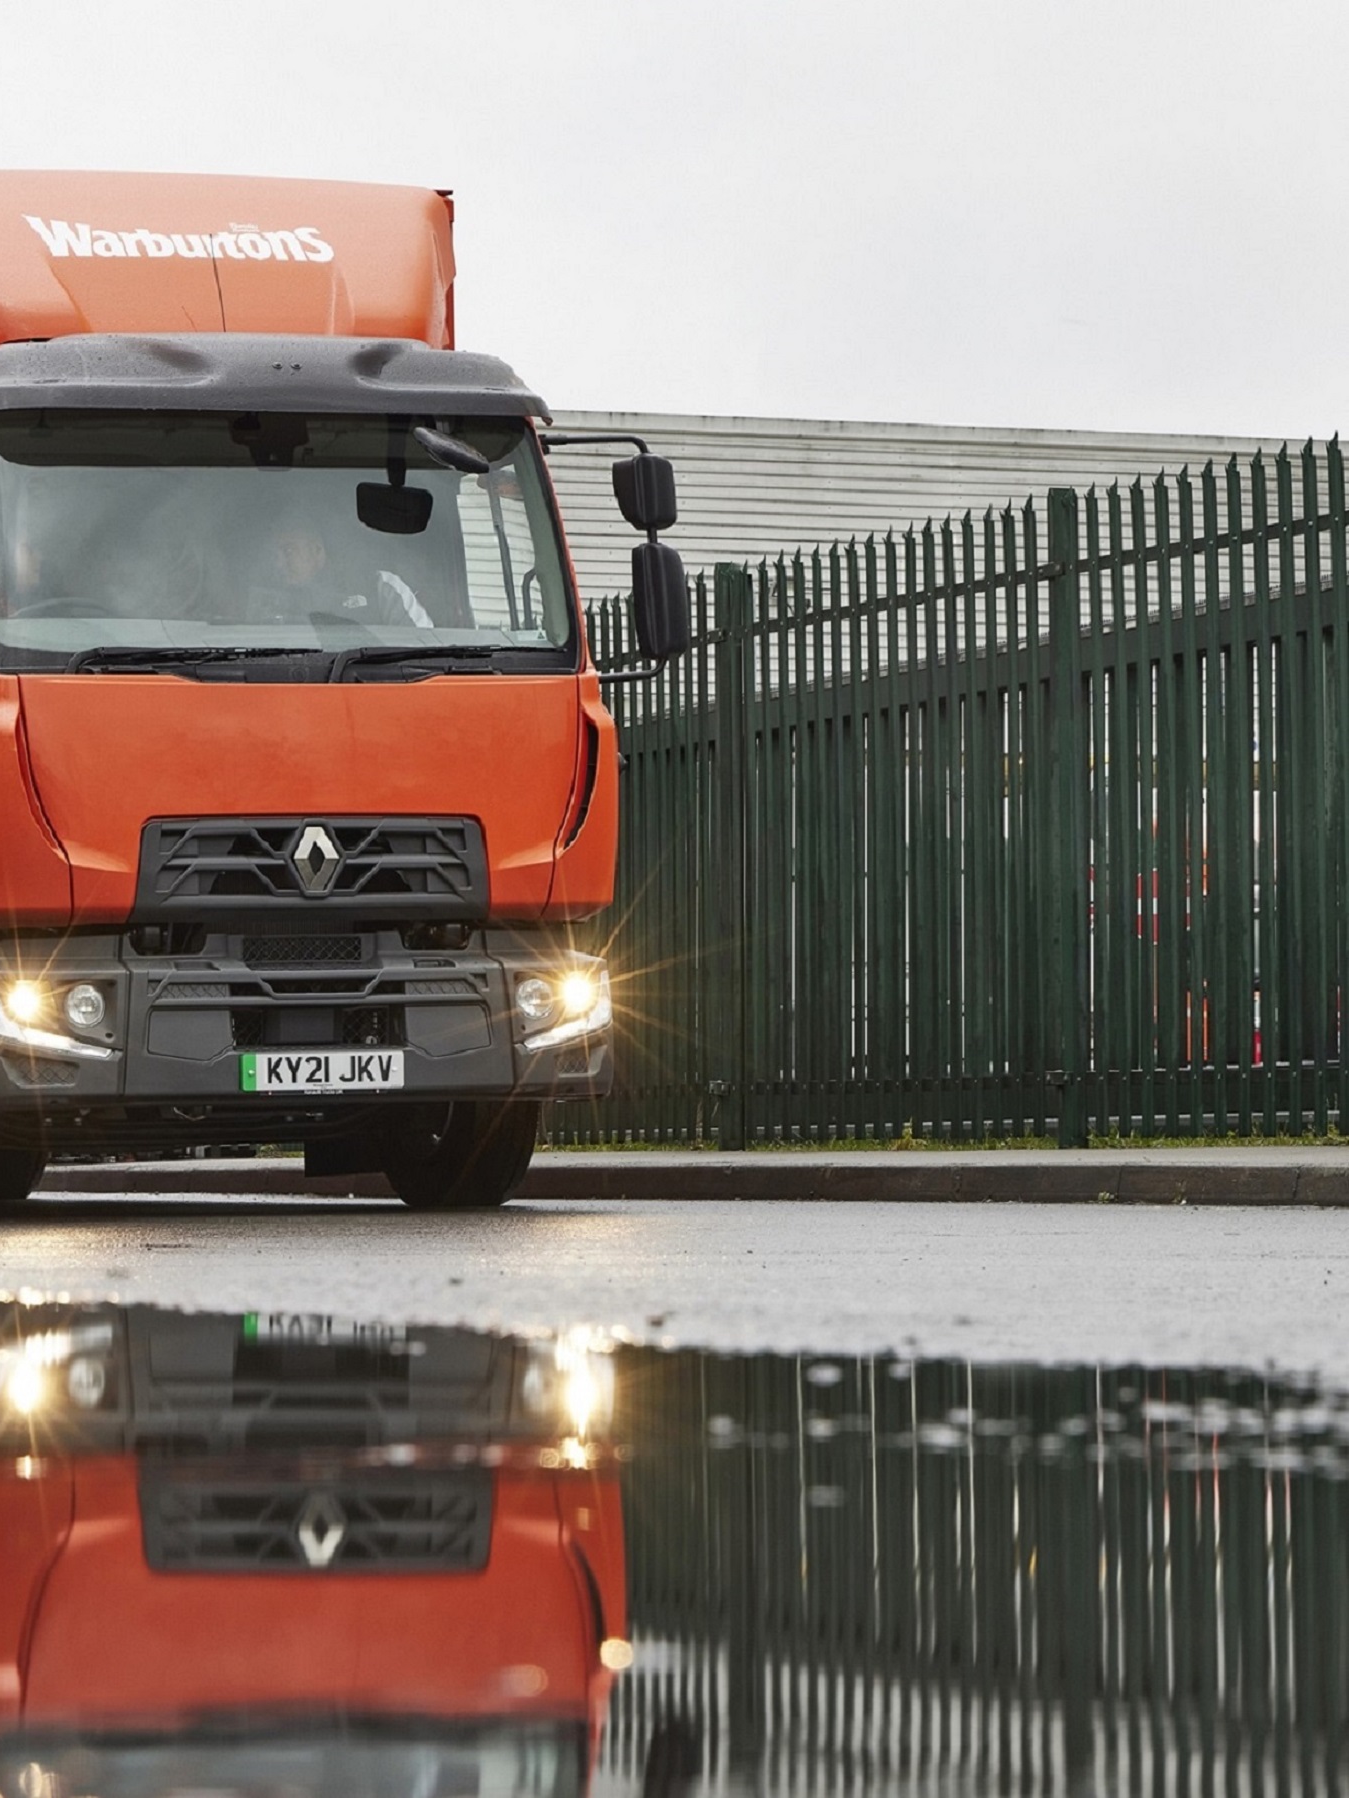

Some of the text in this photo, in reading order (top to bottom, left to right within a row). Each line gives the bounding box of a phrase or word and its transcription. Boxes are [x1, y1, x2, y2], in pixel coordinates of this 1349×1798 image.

[21, 214, 335, 263] Warburtons
[267, 1055, 393, 1084] KY21 JKV
